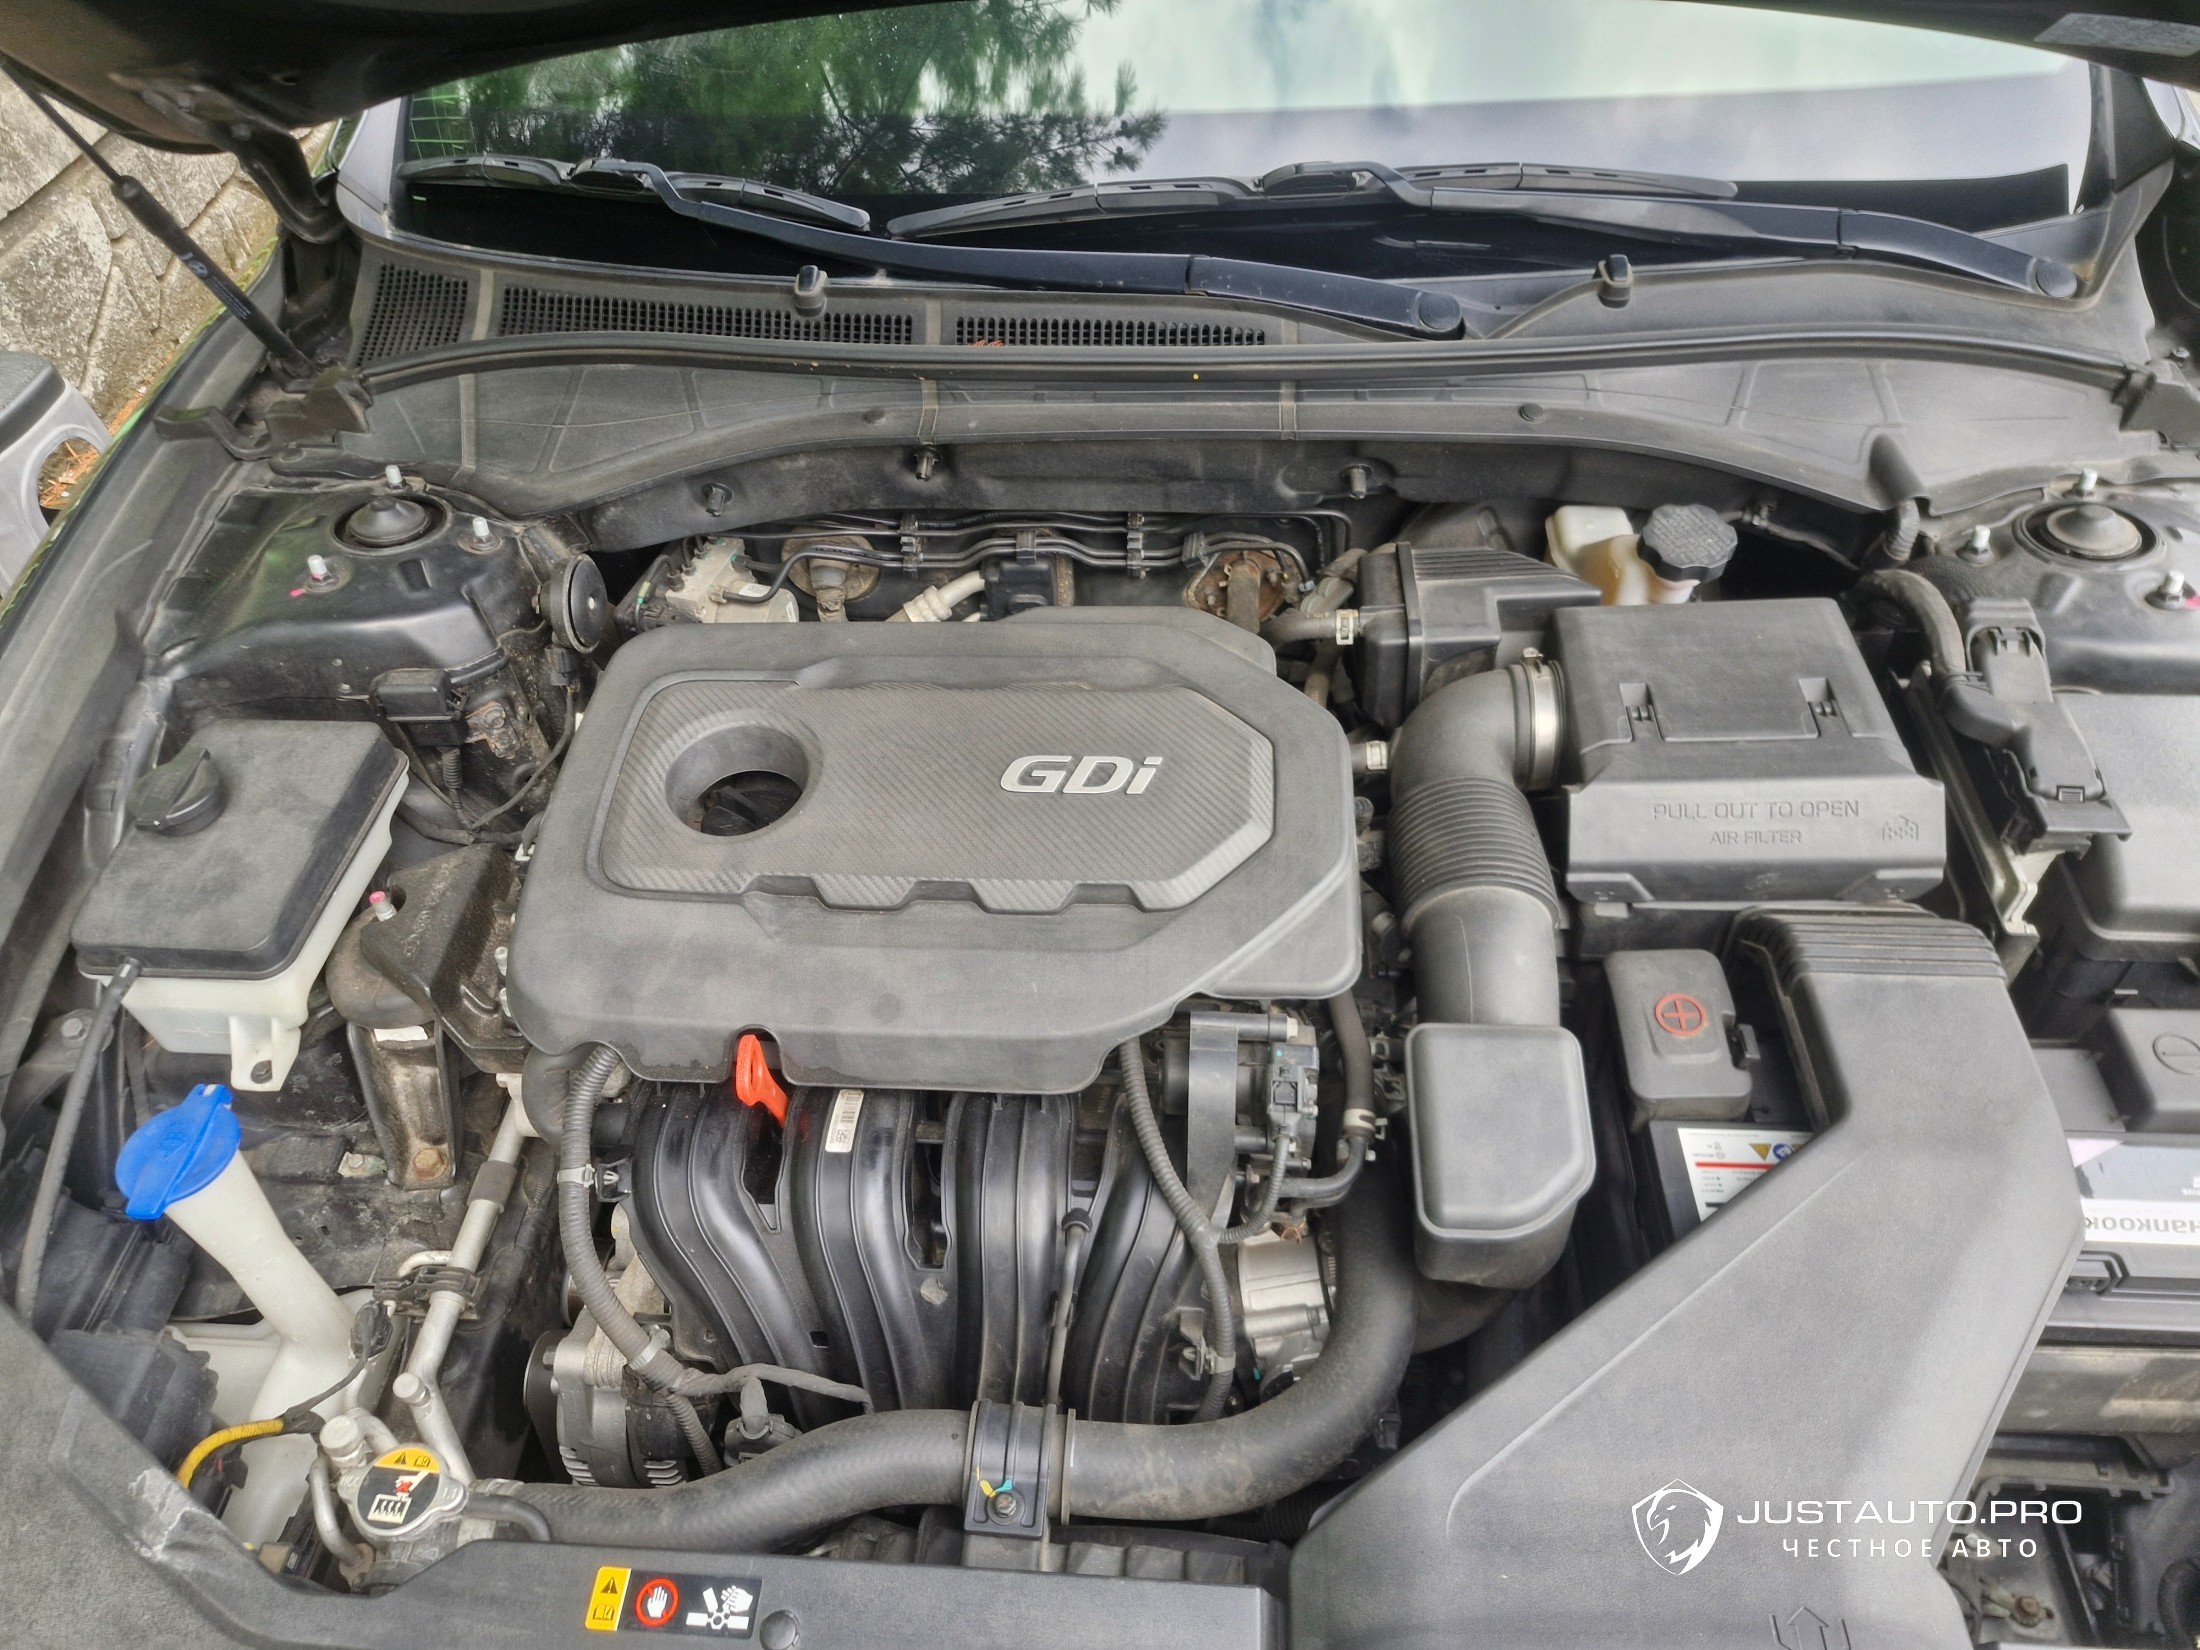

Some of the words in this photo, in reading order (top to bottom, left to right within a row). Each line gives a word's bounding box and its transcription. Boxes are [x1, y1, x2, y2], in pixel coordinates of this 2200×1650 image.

[1000, 755, 1163, 795] GDi
[1653, 802, 1708, 820] PULL
[1714, 801, 1759, 819] OUT
[1768, 801, 1793, 819] TO
[1800, 800, 1860, 818] OPEN
[1710, 830, 1738, 845] AIR
[1744, 829, 1802, 845] FILTER
